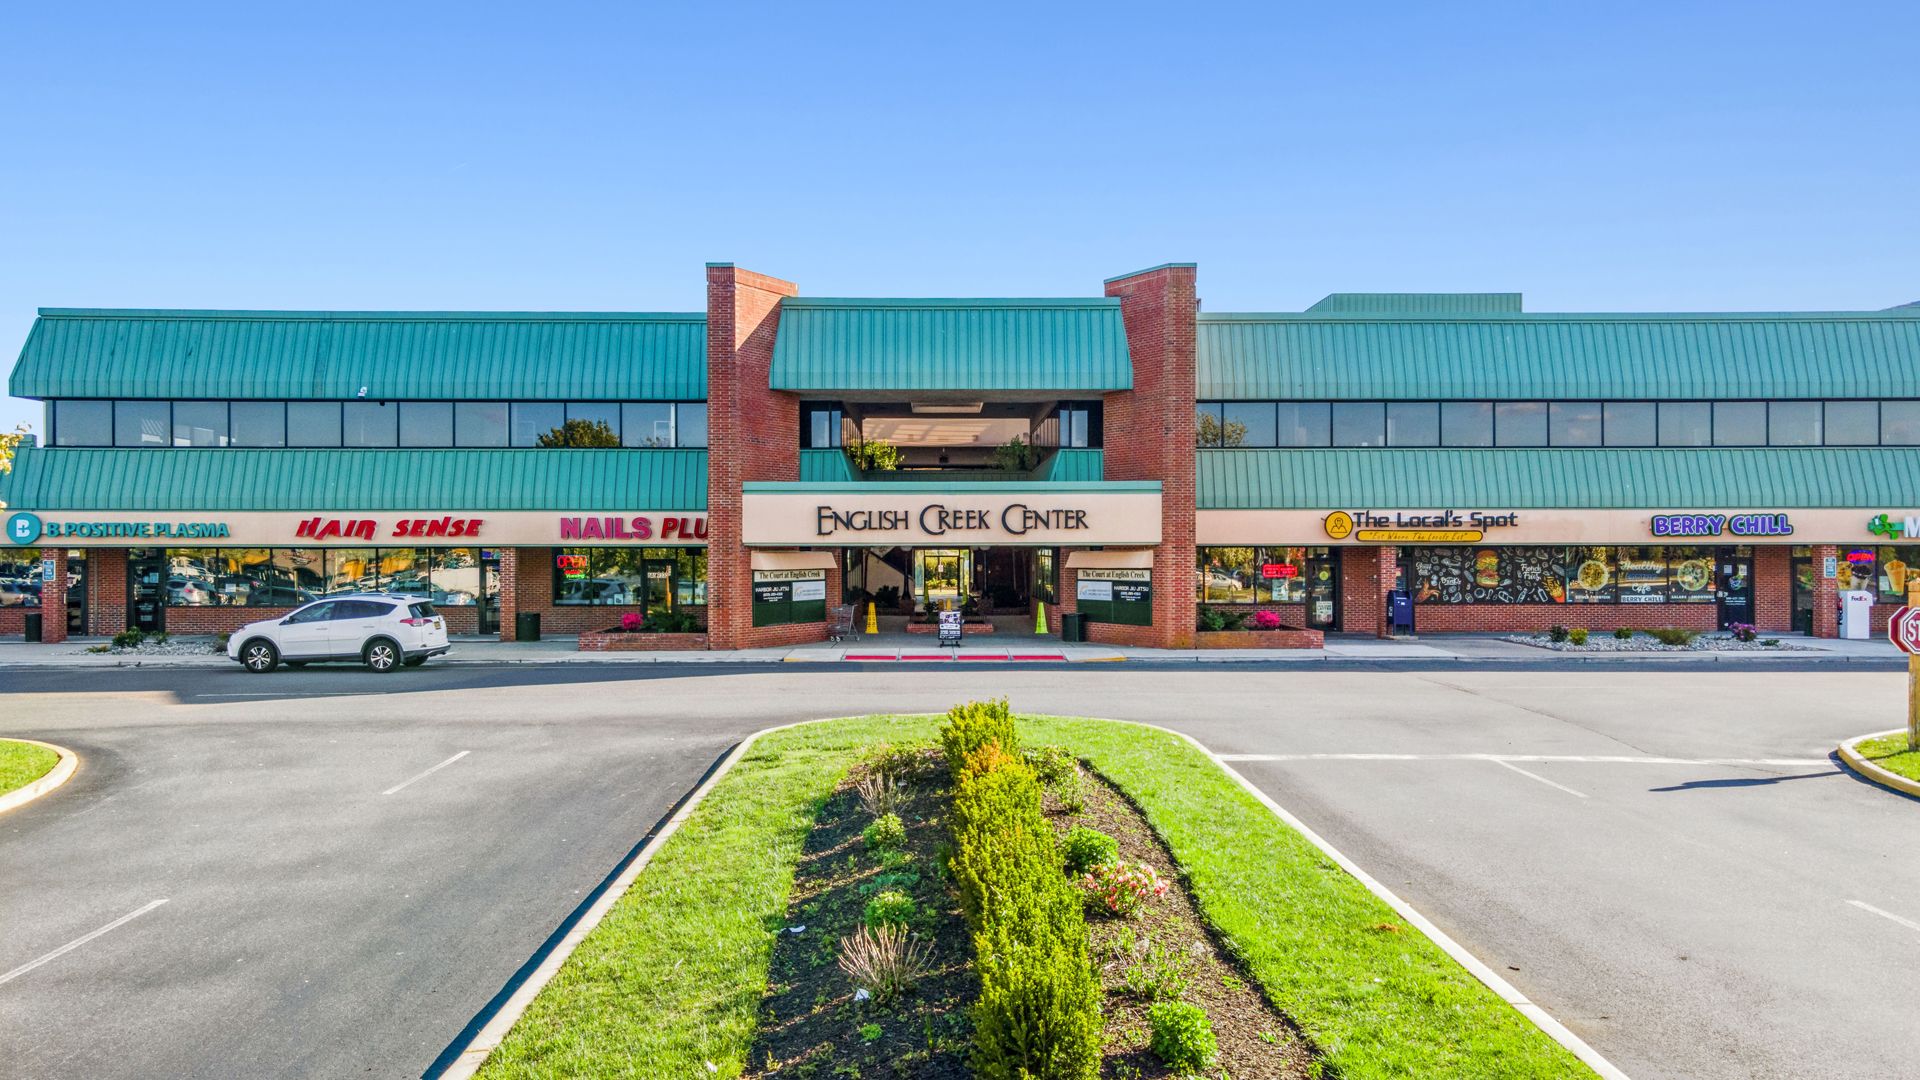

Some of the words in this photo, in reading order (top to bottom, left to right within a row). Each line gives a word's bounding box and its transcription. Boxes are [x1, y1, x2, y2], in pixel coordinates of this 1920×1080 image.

[296, 517, 378, 540] HAIR
[392, 517, 484, 537] SENSE
[560, 517, 653, 540] NAILS
[817, 506, 909, 535] ENGLISH
[919, 504, 990, 535] CREEK
[1001, 504, 1089, 534] CENTER
[1353, 510, 1390, 528] The
[1397, 510, 1463, 528] Local's
[1470, 512, 1519, 532] Spot
[1653, 515, 1726, 536] BERRY
[1730, 515, 1793, 535] CHILL
[47, 523, 60, 537] B
[64, 523, 151, 538] POSITIVE
[154, 523, 230, 538] PLASMA
[557, 555, 588, 568] OPEN
[1620, 561, 1665, 574] Healthy
[790, 570, 807, 579] English
[1112, 571, 1129, 579] English
